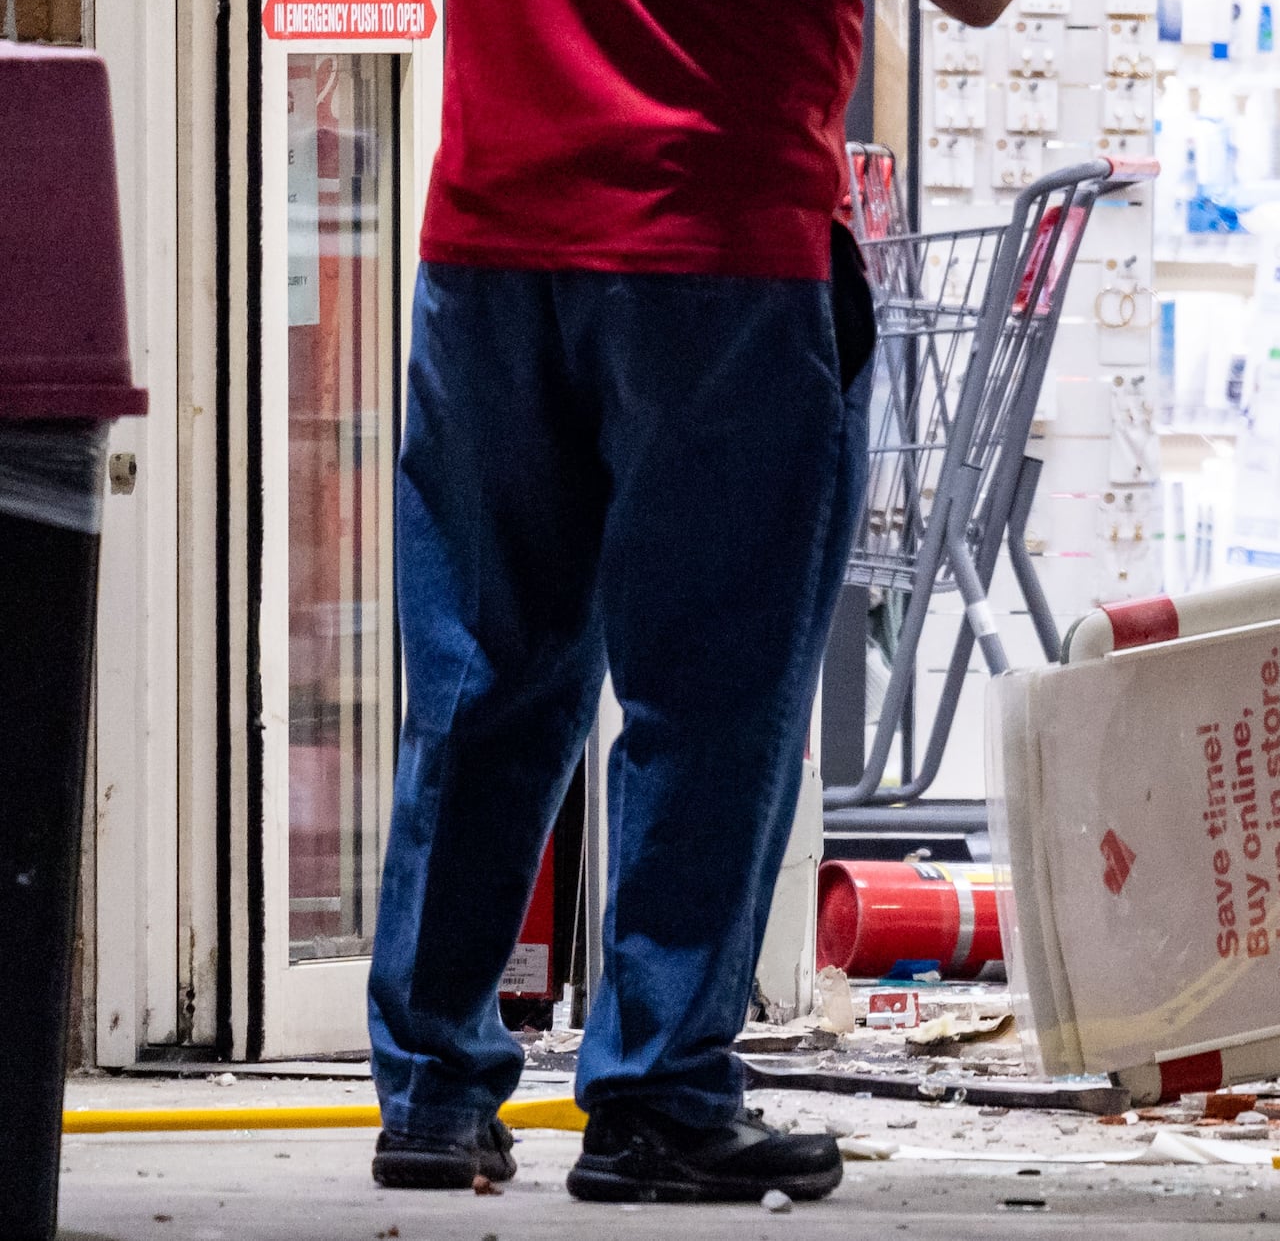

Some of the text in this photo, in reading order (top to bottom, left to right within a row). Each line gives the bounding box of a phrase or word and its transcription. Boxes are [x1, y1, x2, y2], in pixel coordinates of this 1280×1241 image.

[274, 2, 425, 32] IN EMERGENCY PUSH TO OPEN
[1197, 722, 1240, 959] Save time!
[1246, 873, 1271, 958] Buy
